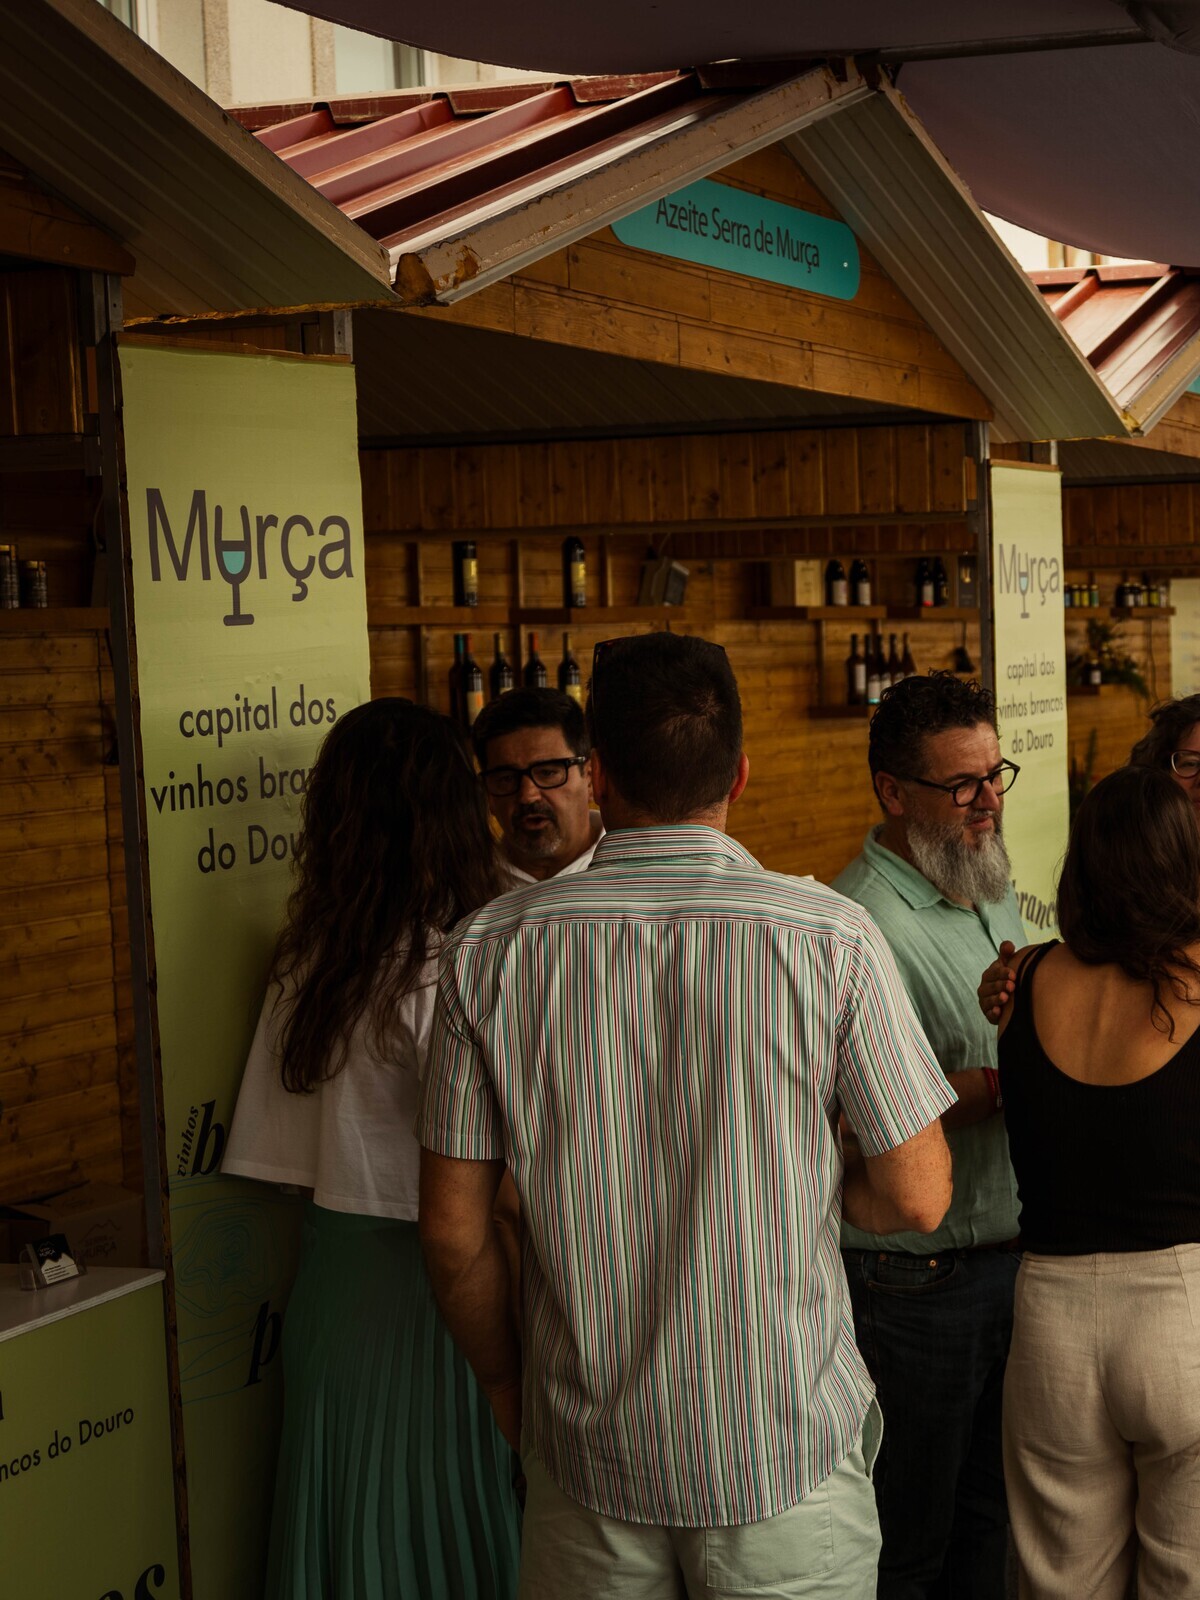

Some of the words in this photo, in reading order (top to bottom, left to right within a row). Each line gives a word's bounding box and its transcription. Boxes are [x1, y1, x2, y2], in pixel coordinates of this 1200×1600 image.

[656, 197, 708, 238] Azeite
[711, 207, 751, 249] Serra
[754, 219, 773, 255] de
[776, 226, 820, 274] Murça
[146, 487, 354, 626] Murça
[999, 543, 1061, 619] Murça
[1006, 652, 1038, 686] capital
[179, 686, 278, 747] capital
[289, 684, 337, 726] dos
[1030, 690, 1064, 717] brancos
[1012, 729, 1024, 755] do
[1027, 729, 1054, 750] Douro
[150, 763, 248, 814] vinhos
[259, 756, 316, 799] bra
[198, 827, 236, 874] do
[177, 1106, 199, 1177] vinhos
[48, 1430, 71, 1459] do
[79, 1408, 134, 1445] Douro
